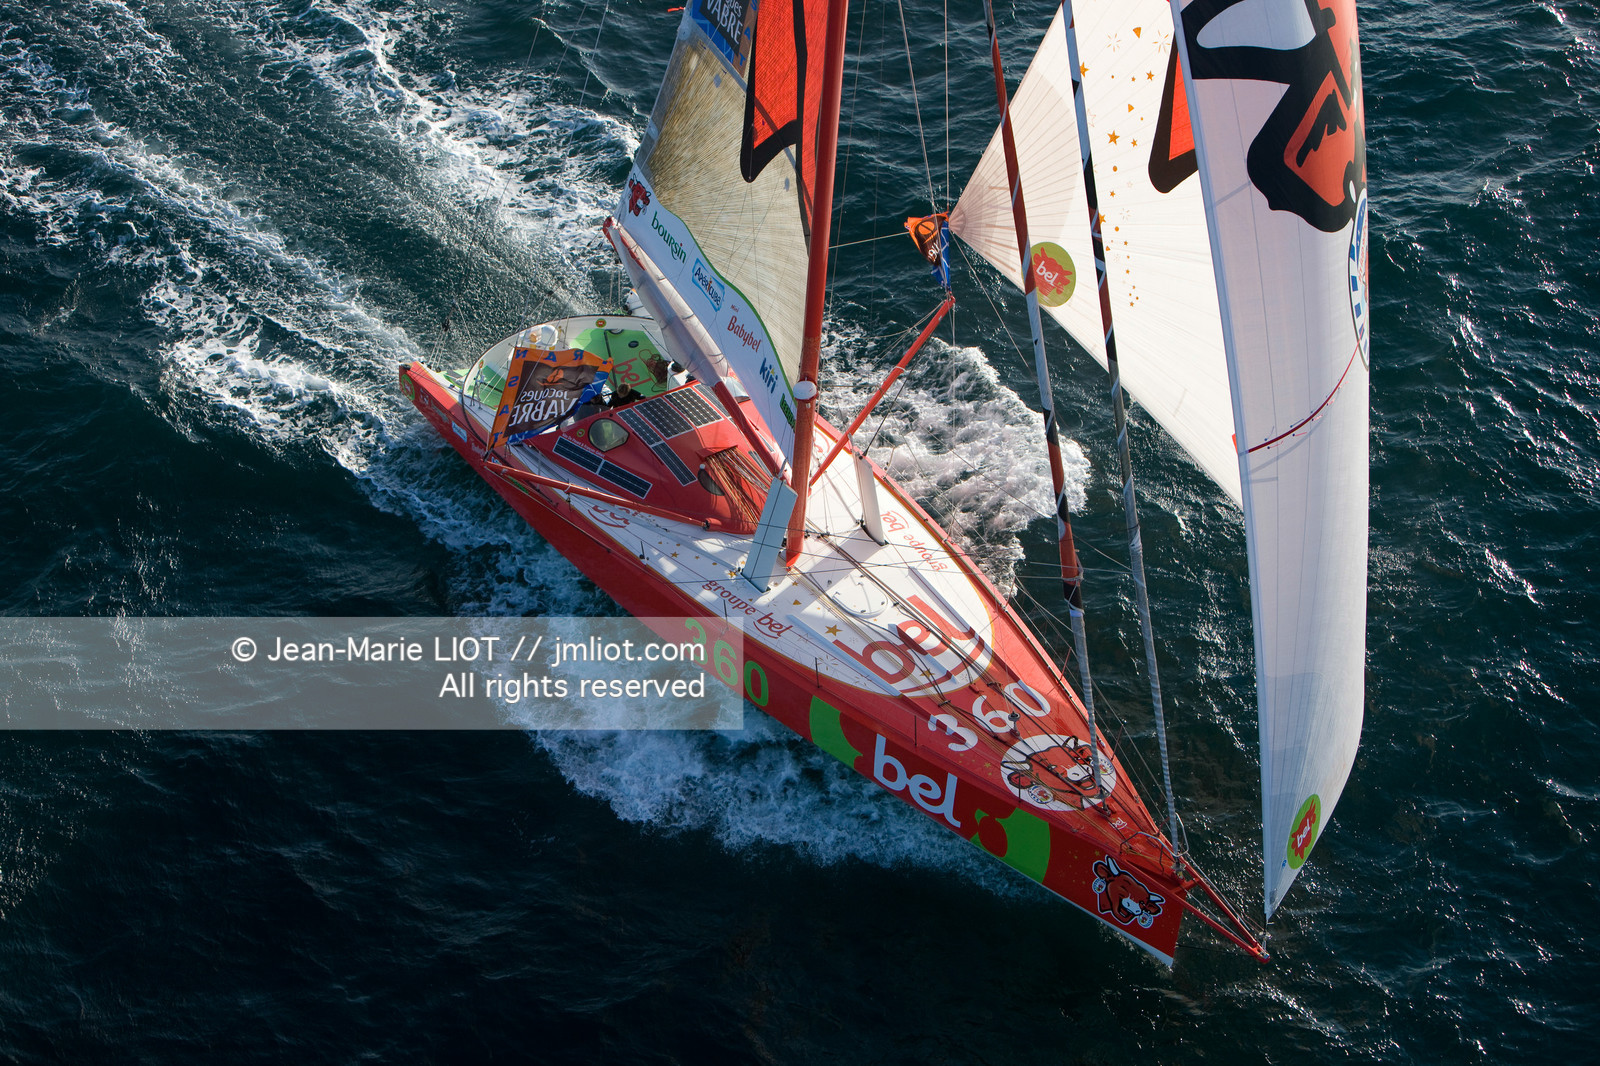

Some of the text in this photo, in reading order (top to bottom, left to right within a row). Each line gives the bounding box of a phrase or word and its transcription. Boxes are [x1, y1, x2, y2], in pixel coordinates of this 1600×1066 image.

[1036, 260, 1059, 287] bel
[727, 315, 762, 352] Babybel
[702, 580, 794, 638] groupe bel
[832, 594, 978, 686] bel
[685, 617, 769, 707] 360
[927, 682, 1052, 752] 360
[873, 733, 961, 828] bel
[1296, 818, 1310, 848] bel
